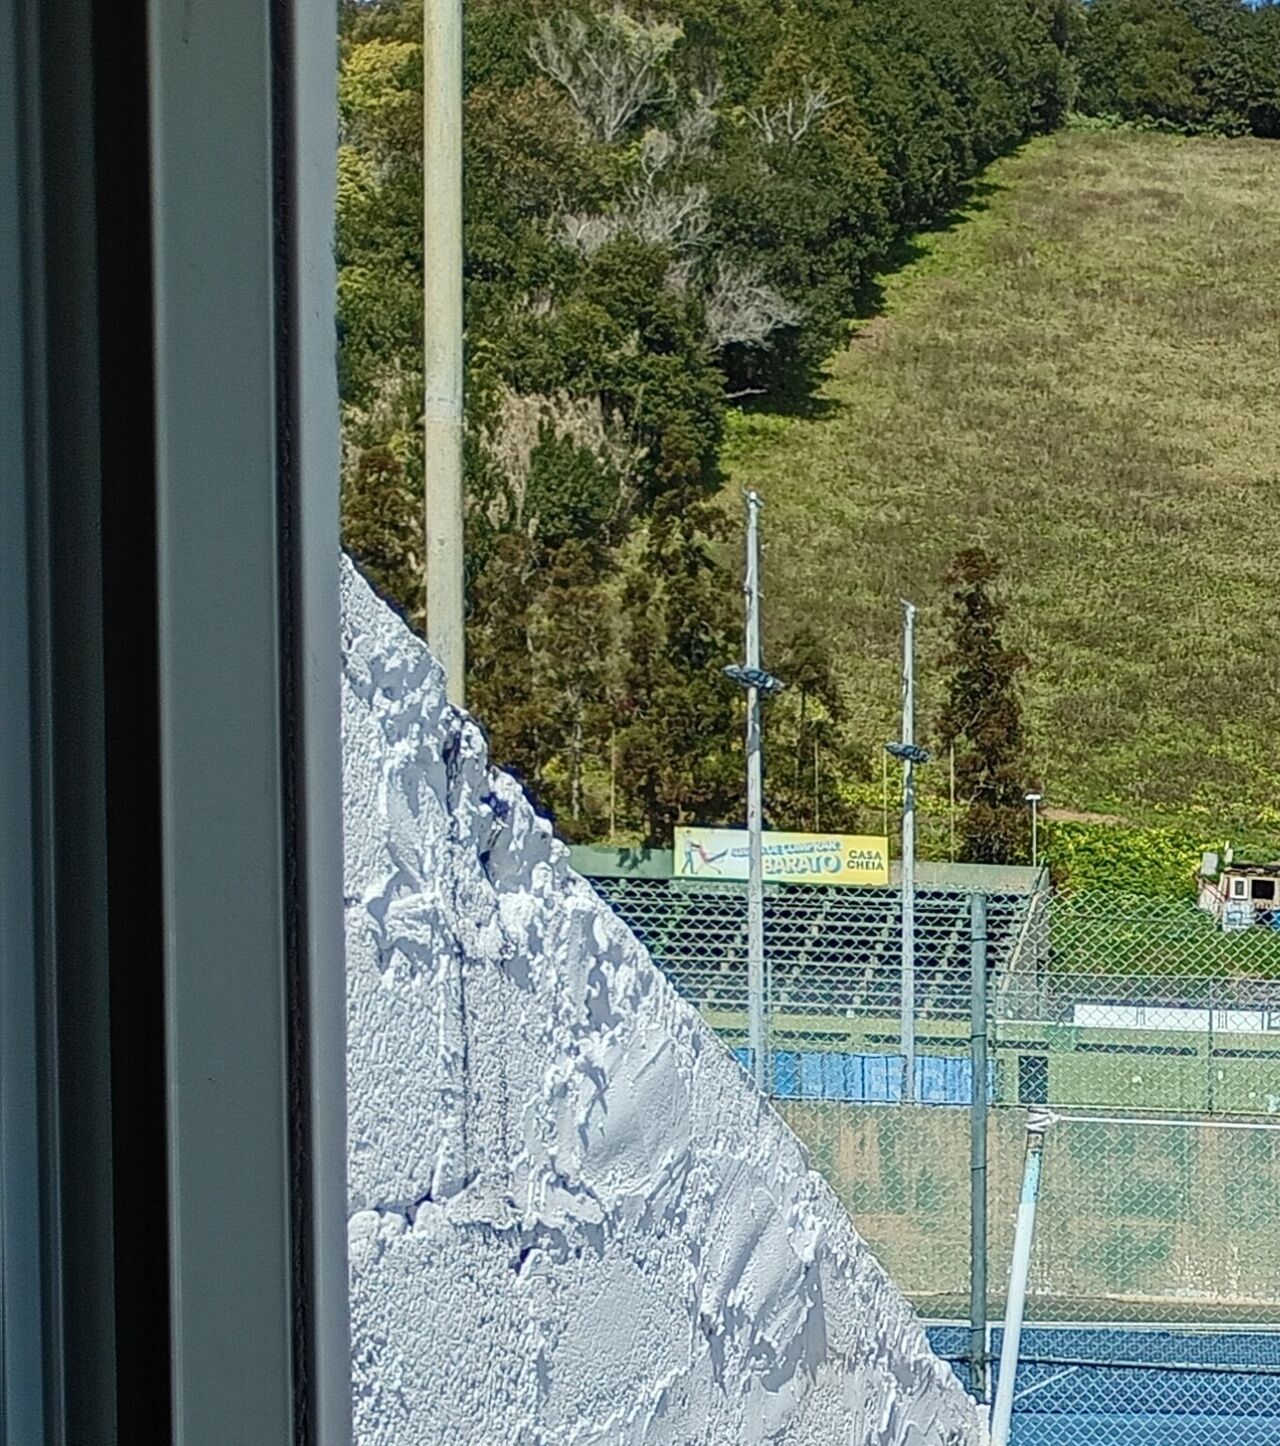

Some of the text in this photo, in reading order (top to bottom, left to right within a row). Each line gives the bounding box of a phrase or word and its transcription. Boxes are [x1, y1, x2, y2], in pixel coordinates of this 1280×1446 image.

[848, 849, 882, 860] CASA
[763, 855, 841, 875] BARATO
[846, 859, 885, 871] CHEIA
